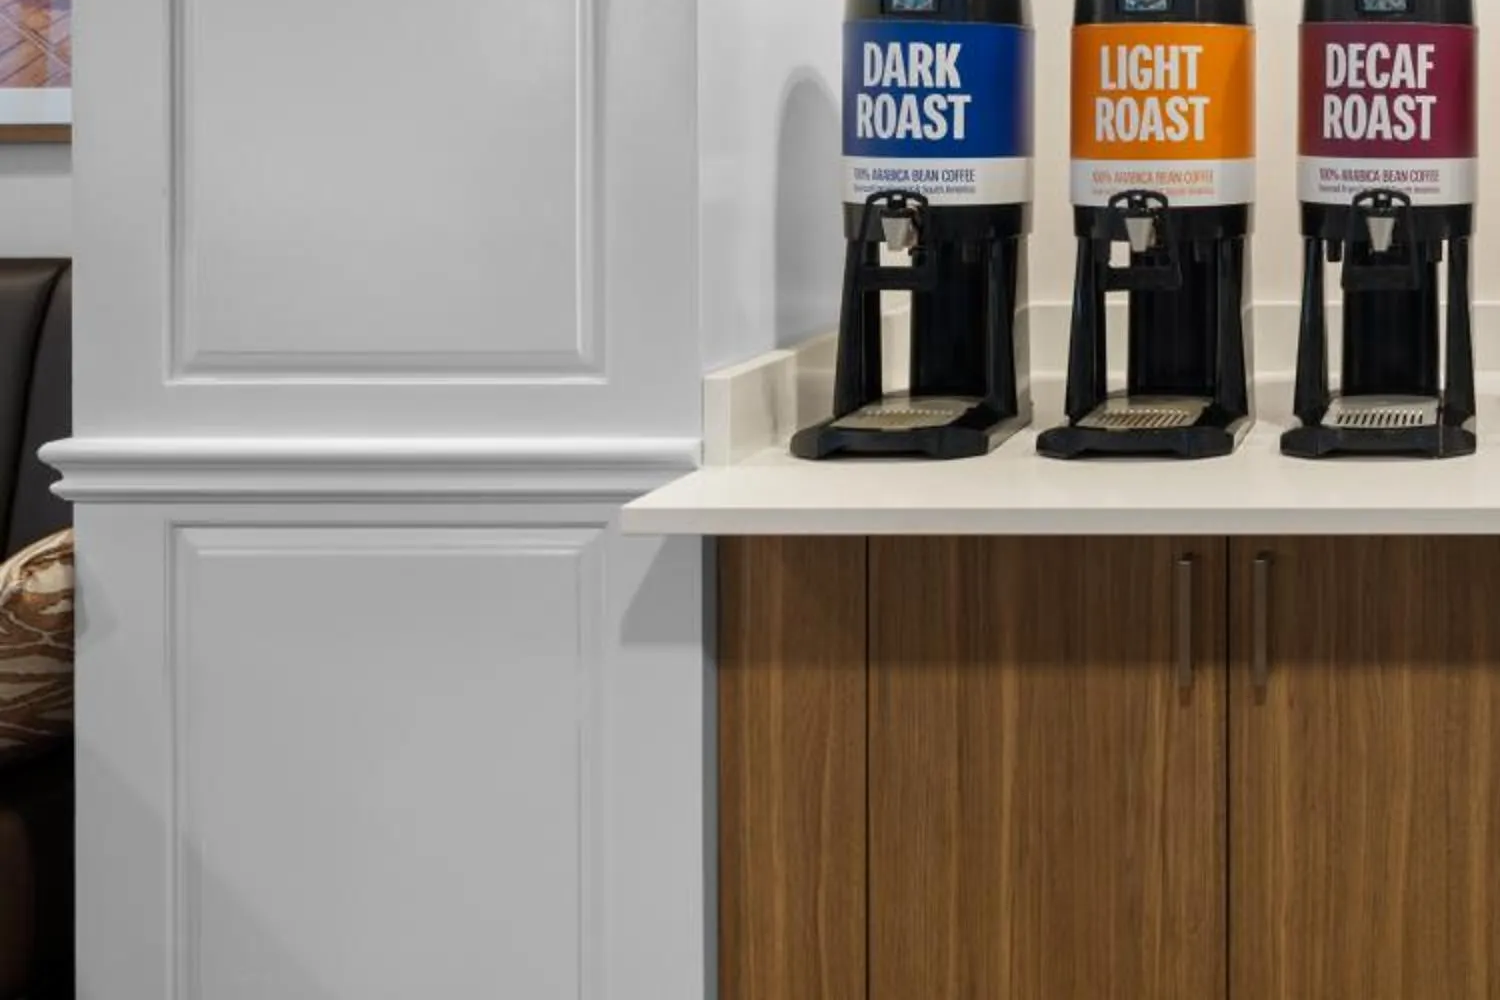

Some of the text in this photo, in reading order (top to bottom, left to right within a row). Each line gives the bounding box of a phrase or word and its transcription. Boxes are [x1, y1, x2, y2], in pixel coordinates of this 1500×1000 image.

[863, 42, 962, 89] DARK
[1100, 44, 1203, 91] LIGHT
[1325, 43, 1435, 89] DECAF
[856, 94, 972, 141] ROAST
[1095, 96, 1210, 143] ROAST
[1322, 95, 1437, 141] ROAST
[872, 167, 910, 181] ARABICA
[911, 168, 939, 182] BEAN
[941, 168, 976, 183] COFFEE
[1155, 170, 1182, 185] BEAN
[1183, 169, 1214, 185] COFFEE
[1341, 168, 1381, 182] ARABICA
[1382, 168, 1409, 183] BEAN
[1409, 168, 1440, 183] COFFEE
